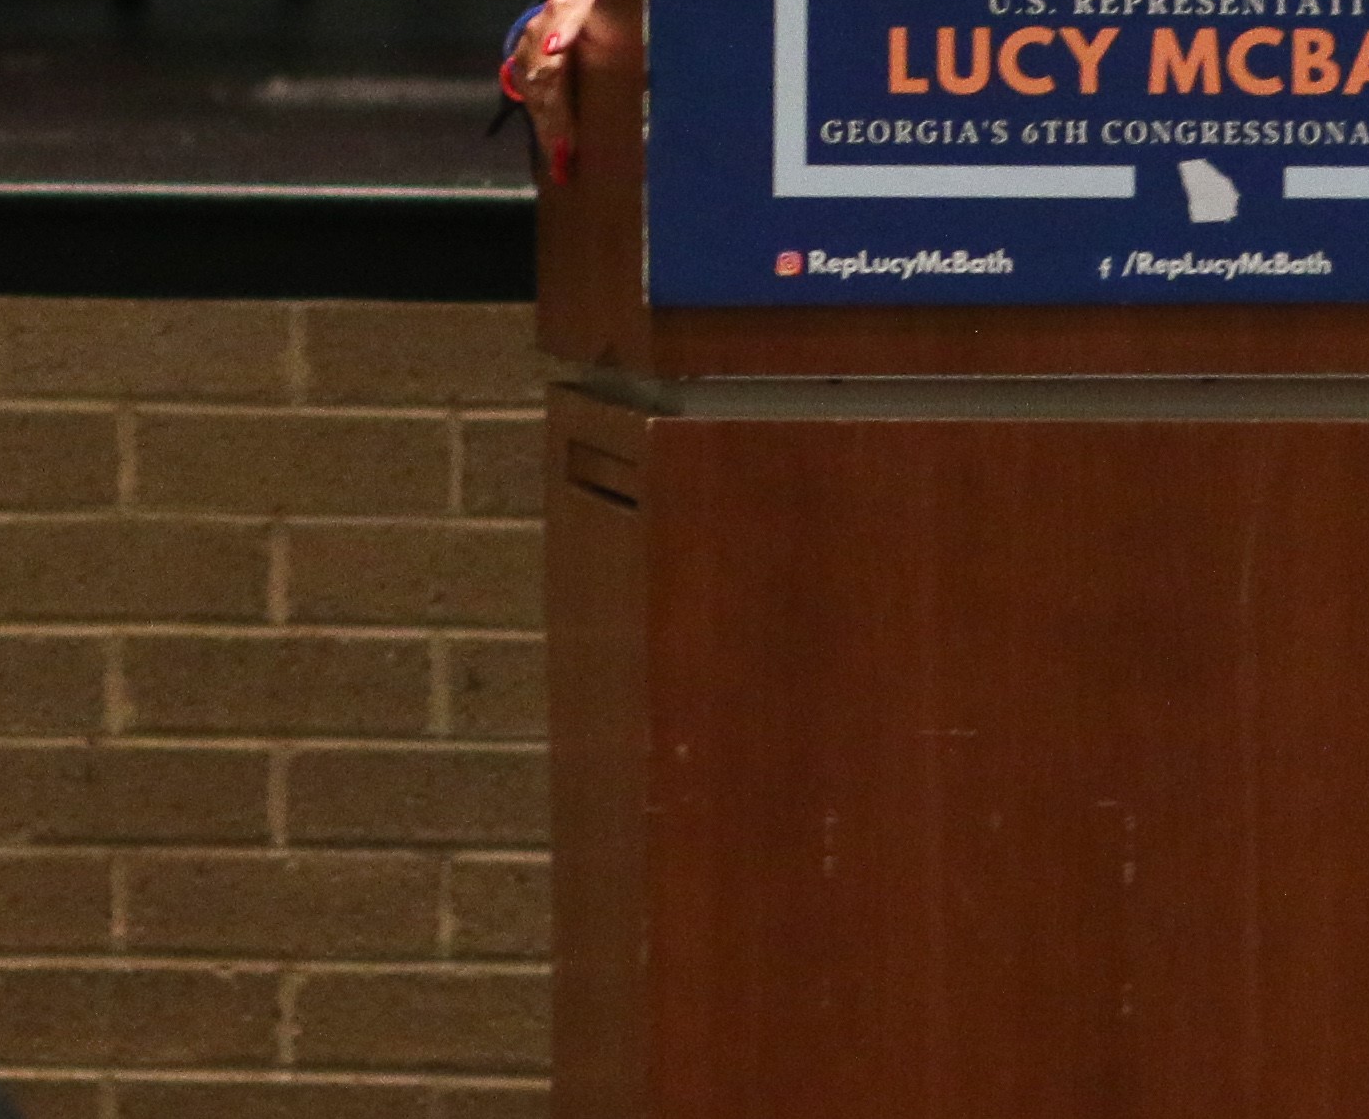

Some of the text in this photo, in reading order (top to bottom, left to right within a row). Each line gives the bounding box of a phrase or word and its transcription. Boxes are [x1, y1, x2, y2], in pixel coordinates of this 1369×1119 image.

[888, 26, 1119, 95] LUCY
[820, 118, 1008, 144] GEORGIA'S
[1022, 120, 1088, 144] 6TH
[807, 248, 1014, 280] RepLucyMcBath
[1121, 250, 1333, 281] /RepLucyMcBath
